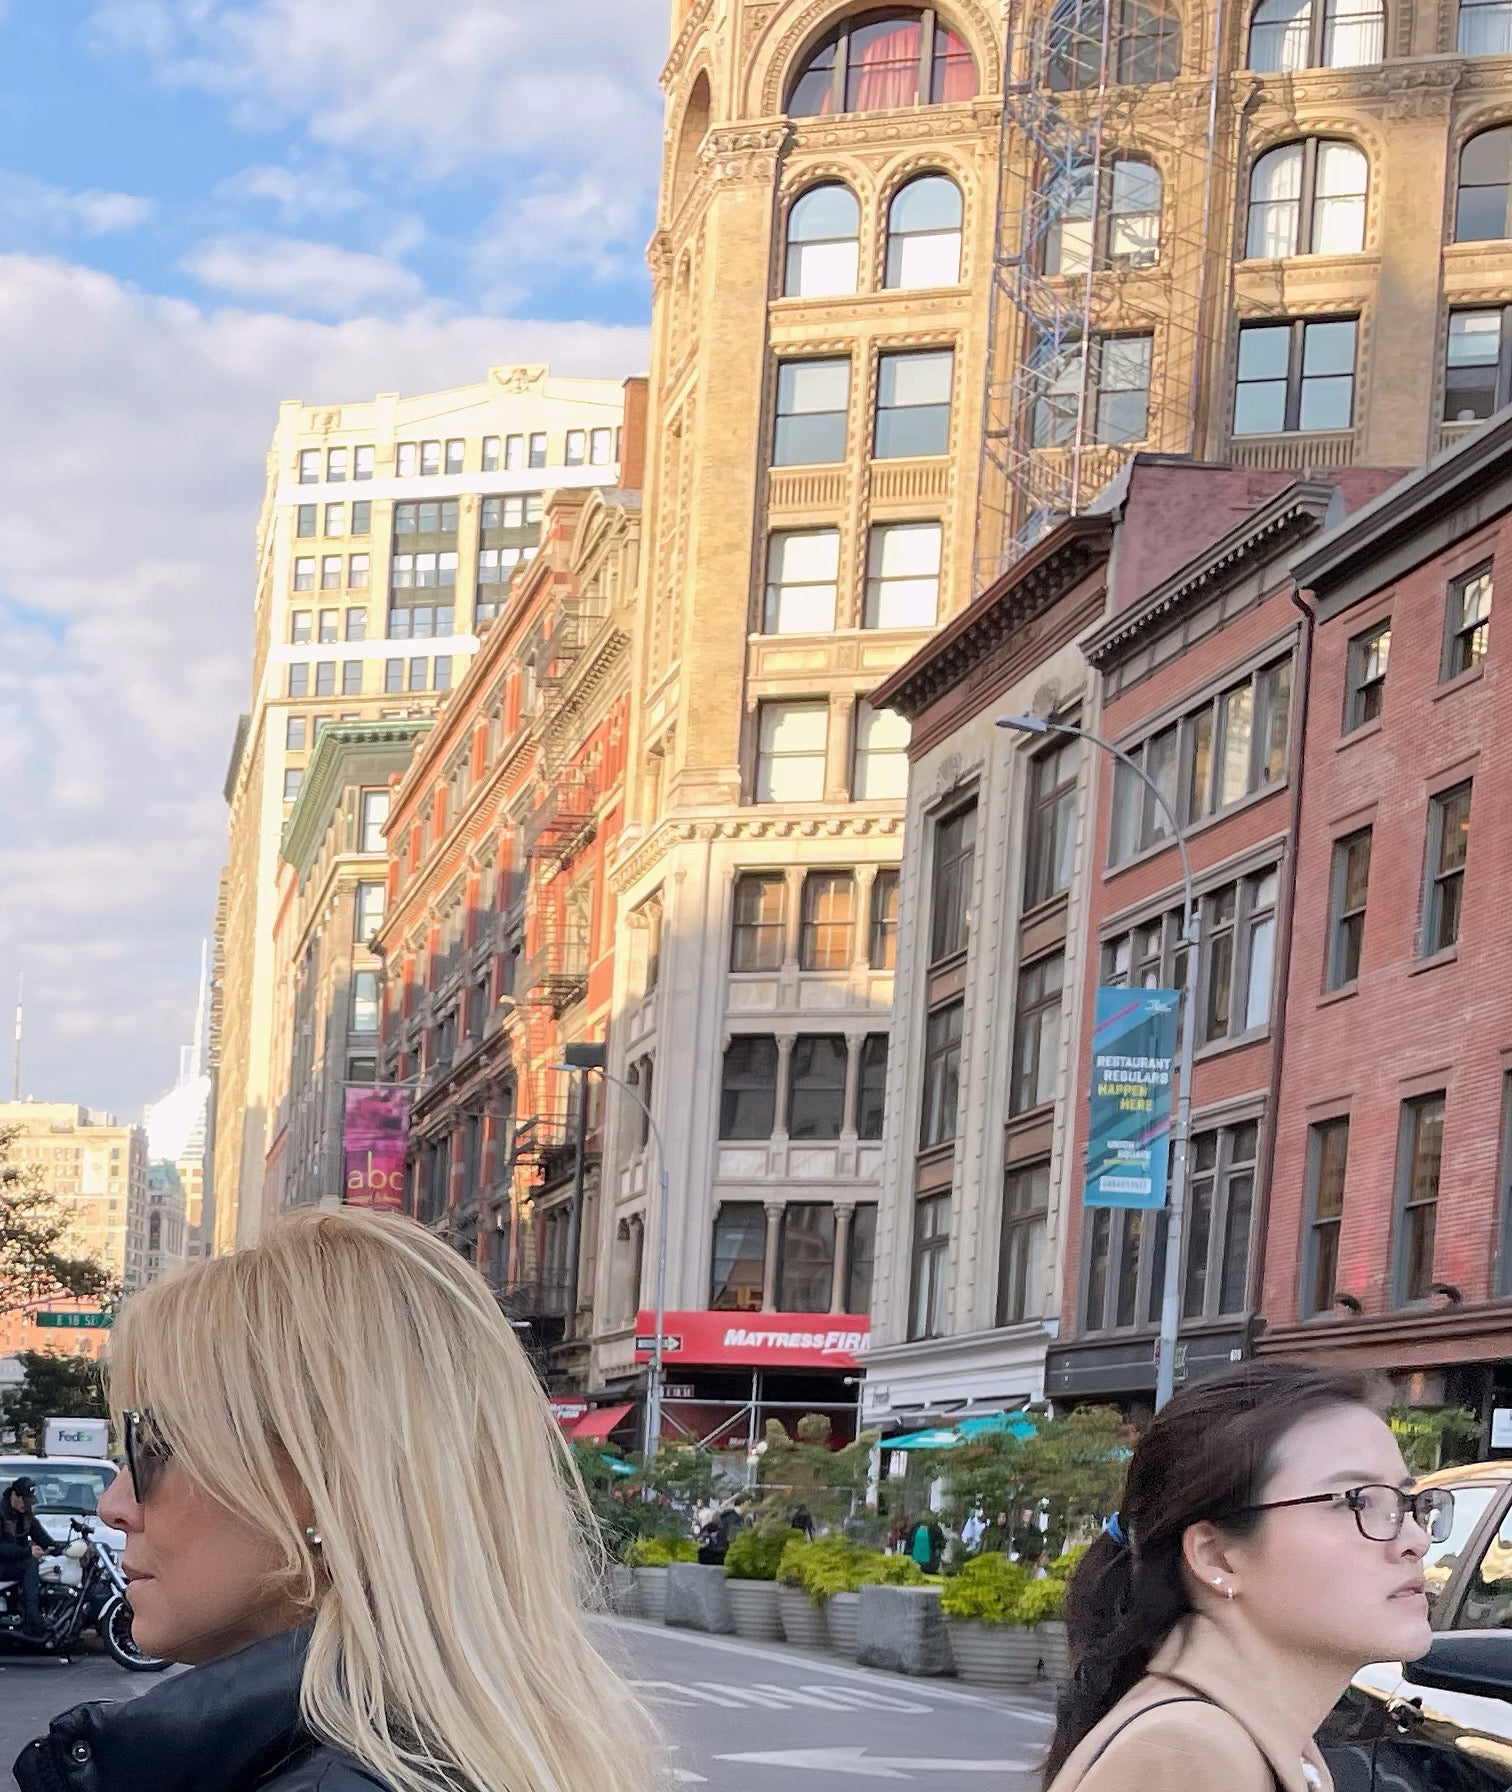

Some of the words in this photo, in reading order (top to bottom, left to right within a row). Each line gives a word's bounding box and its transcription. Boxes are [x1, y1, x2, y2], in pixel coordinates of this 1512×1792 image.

[1096, 1055, 1172, 1071] RESTAURANT
[1097, 1083, 1149, 1097] HAPPEN
[1119, 1098, 1153, 1112] HERE
[348, 1150, 405, 1191] abc
[58, 1430, 94, 1442] FedEx
